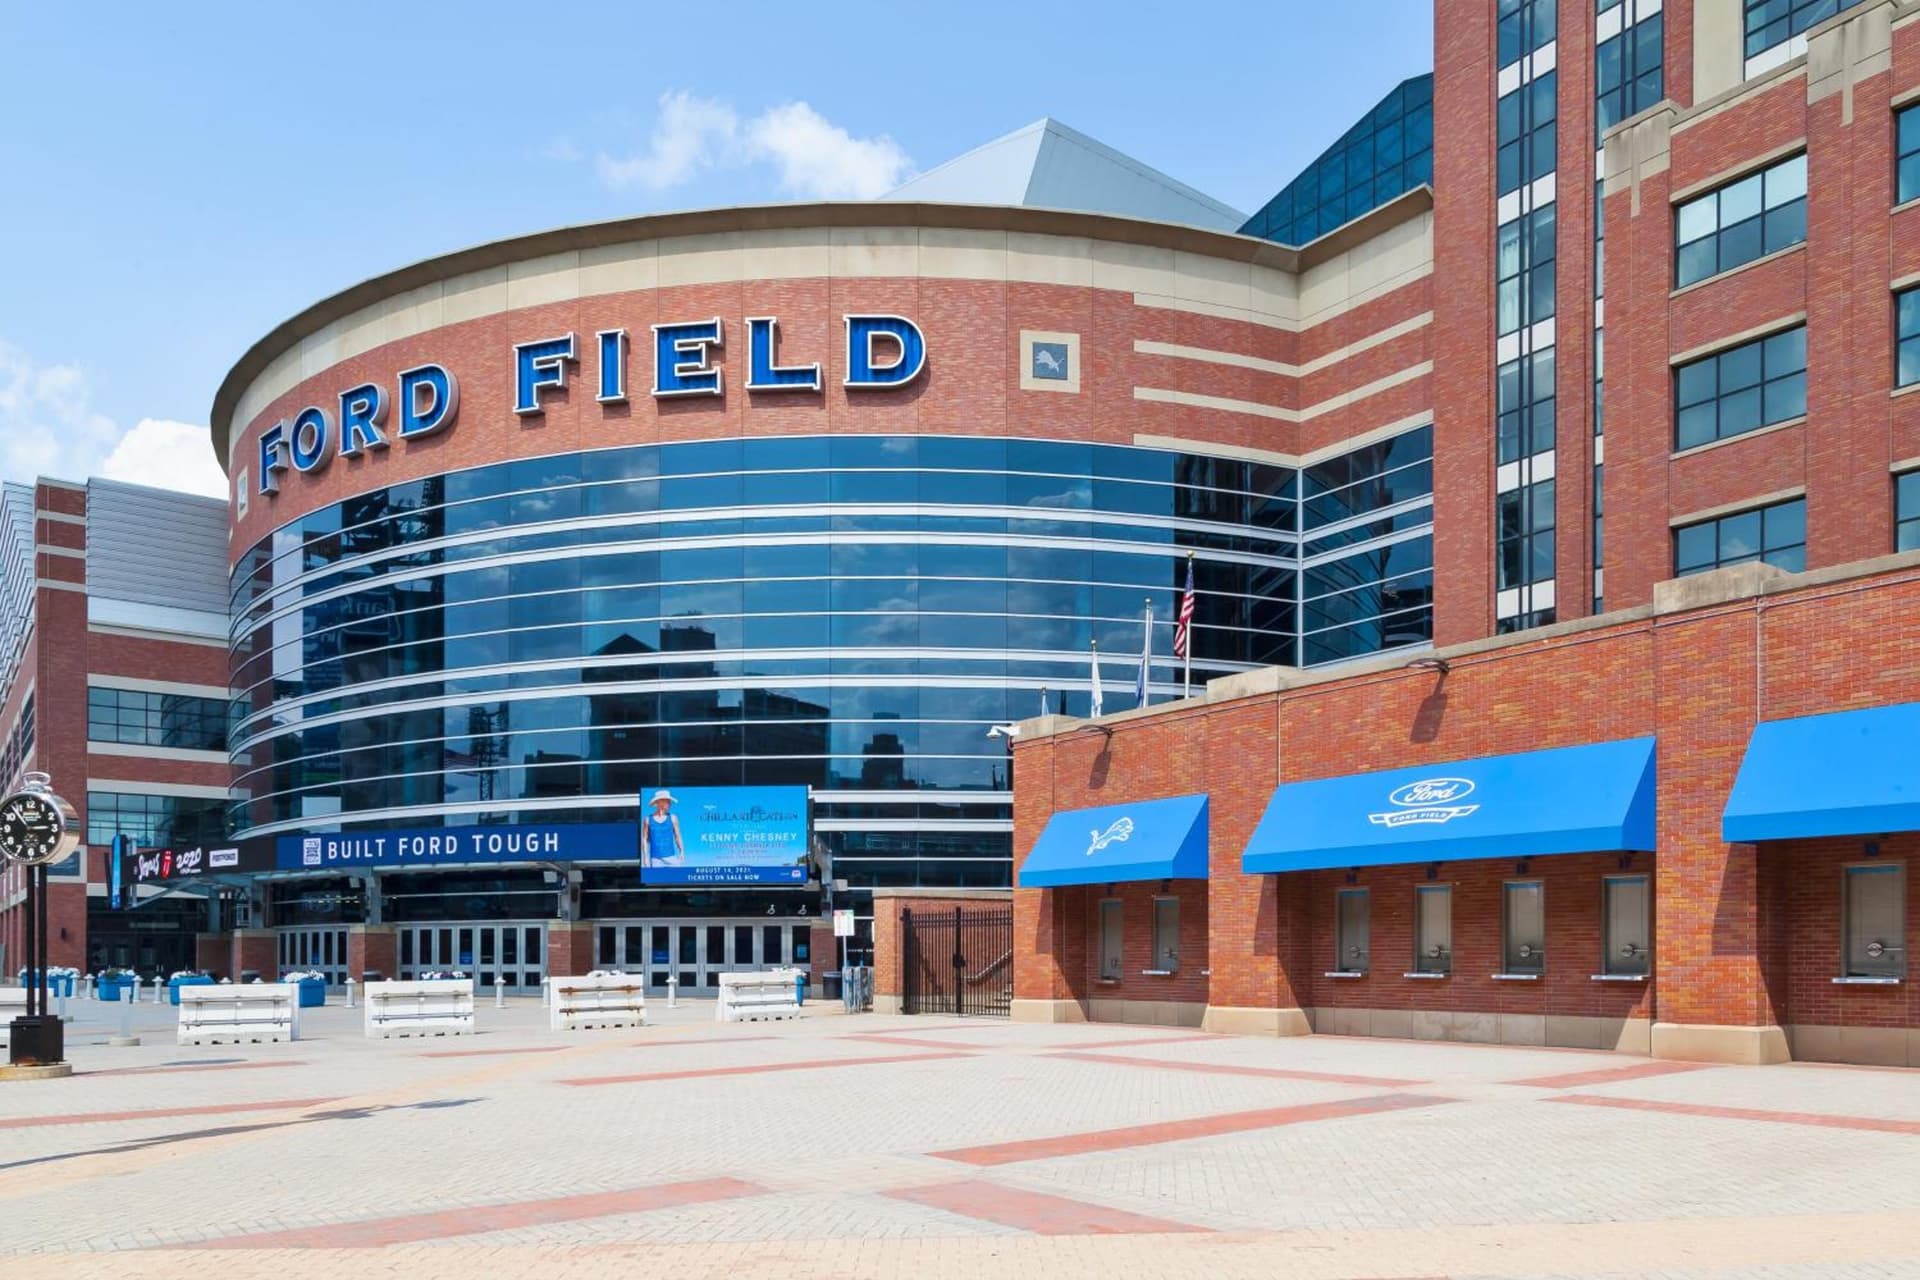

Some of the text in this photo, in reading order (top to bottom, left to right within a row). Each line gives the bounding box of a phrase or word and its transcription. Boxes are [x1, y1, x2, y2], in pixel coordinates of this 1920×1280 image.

[258, 314, 928, 496] FORD FIELD
[1404, 781, 1459, 802] Ford
[26, 800, 35, 808] 12
[6, 812, 16, 821] 10
[48, 812, 55, 820] 2
[1420, 811, 1448, 819] FIELD
[4, 824, 11, 833] 9
[51, 824, 58, 832] 3
[7, 836, 14, 845] 8
[48, 835, 55, 844] 4
[701, 832, 798, 842] KENNY CHESNEY
[40, 844, 47, 853] 5
[328, 839, 386, 860] BUILT
[398, 835, 458, 856] FORD
[472, 832, 559, 854] TOUGH
[27, 847, 35, 856] 6
[176, 847, 202, 870] 2020
